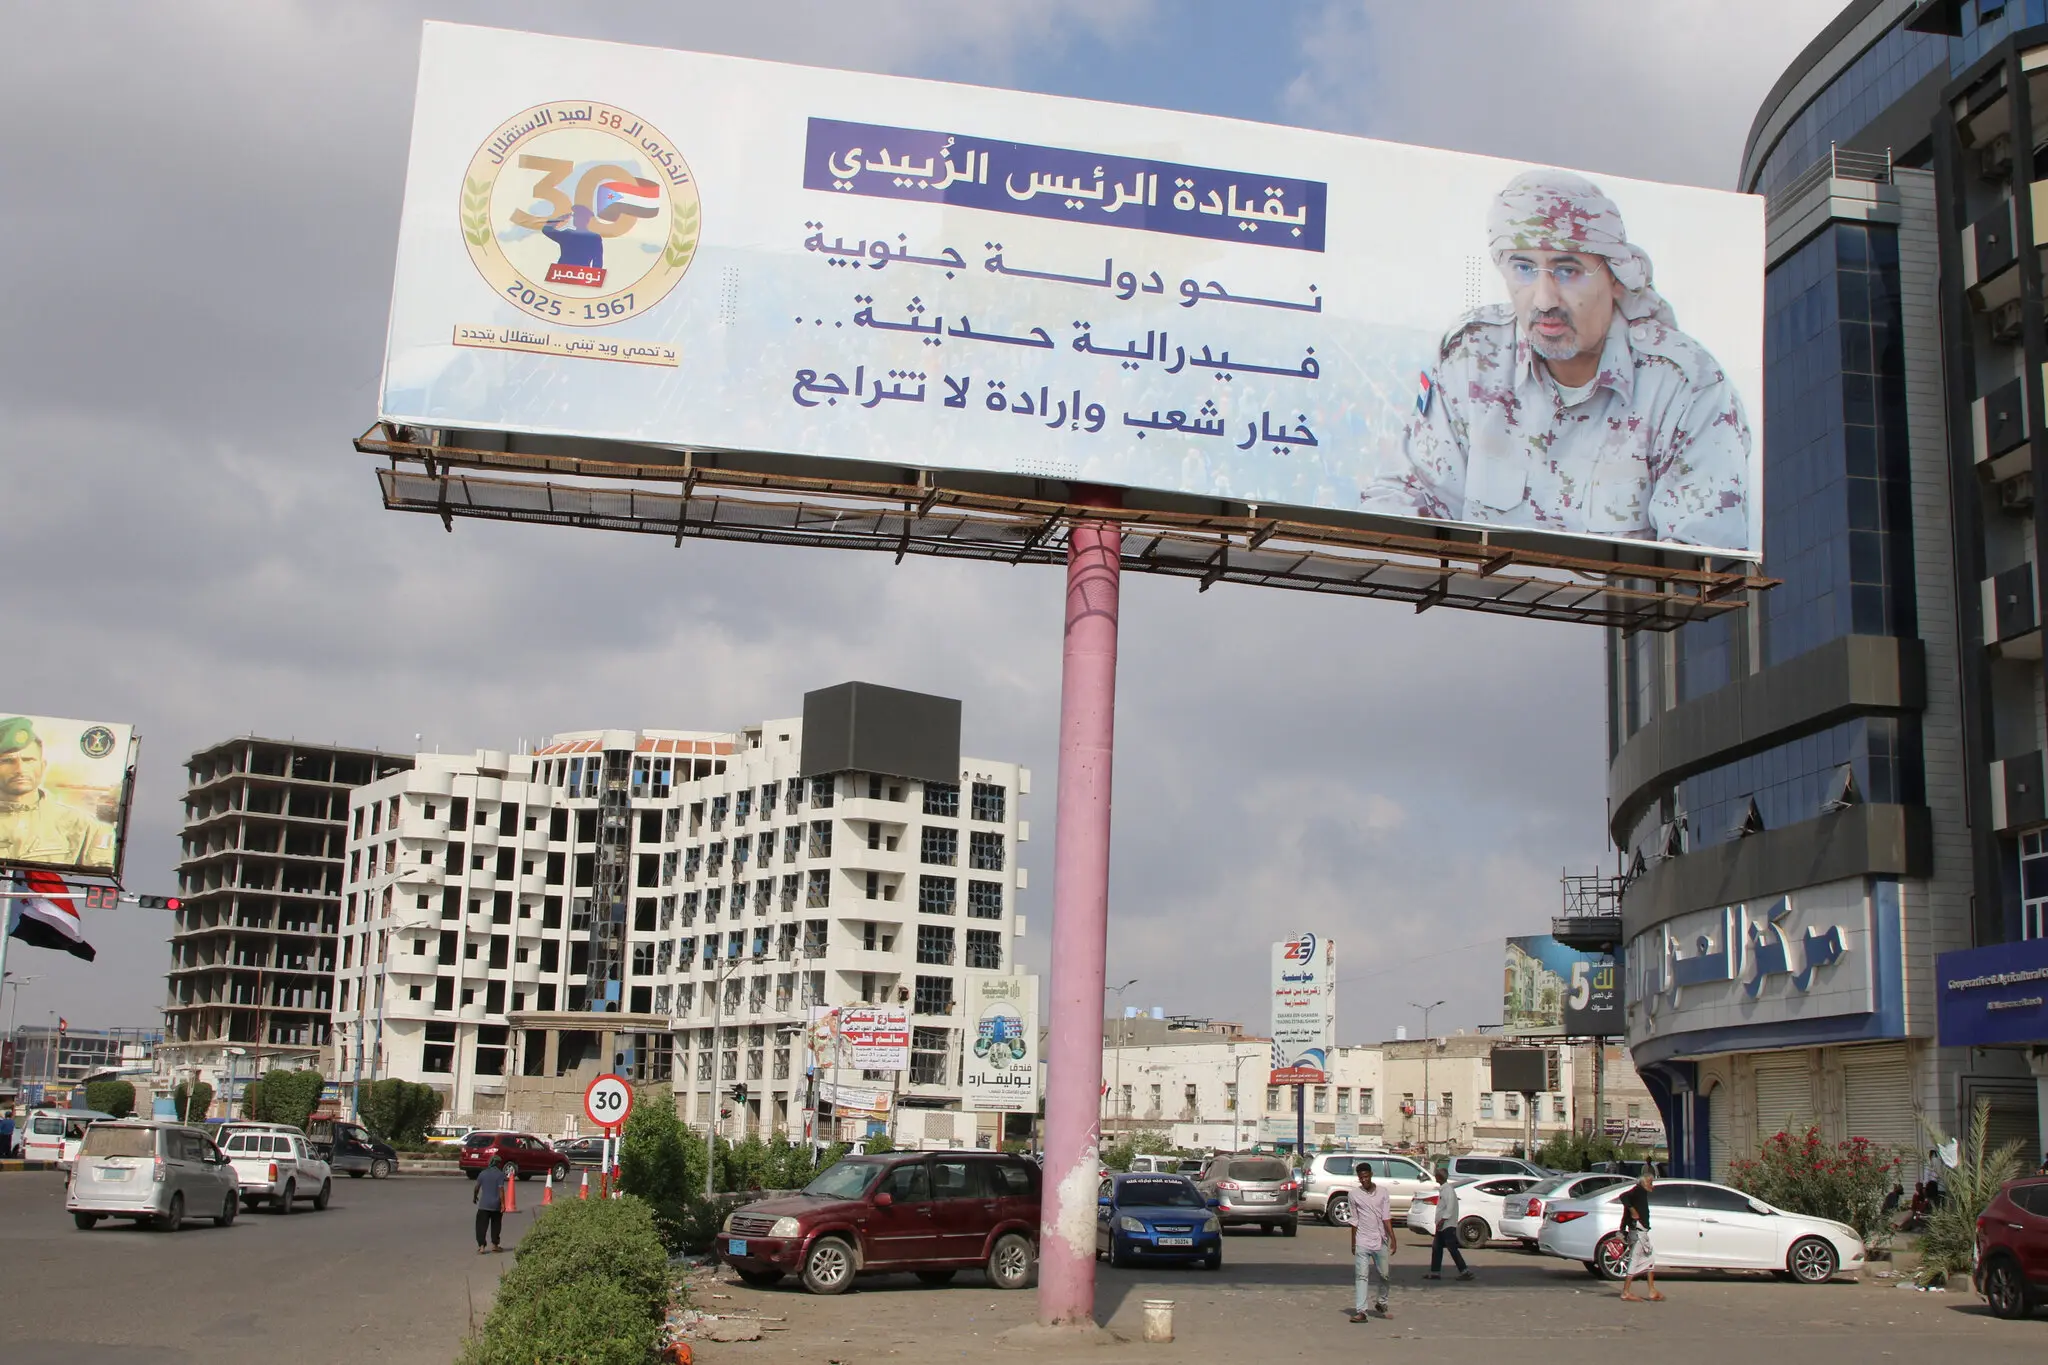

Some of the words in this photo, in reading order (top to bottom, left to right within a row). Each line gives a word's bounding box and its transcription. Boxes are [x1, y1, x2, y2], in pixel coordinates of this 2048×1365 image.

[557, 106, 593, 125] لعيد
[597, 110, 623, 130] 58
[487, 108, 553, 165] الاستقلال
[642, 137, 689, 186] الذكرى
[509, 154, 638, 239] 30
[1005, 165, 1157, 211] الرئيس
[1173, 177, 1307, 237] بقيادة
[803, 220, 967, 280] جنوبية
[551, 268, 602, 285] نوفمبر
[984, 241, 1164, 300] دولة
[506, 280, 562, 316] 2025
[583, 293, 636, 320] 1967
[1179, 278, 1322, 313] نحو
[460, 327, 495, 341] يتجدد
[499, 329, 550, 346] استقلال
[565, 339, 594, 353] تبني
[598, 342, 618, 355] ويد
[622, 346, 660, 360] تحمي
[664, 349, 676, 361] يد
[1072, 320, 1320, 382] فيدرالية
[792, 365, 927, 408] تتراجع
[943, 374, 970, 409] لا
[985, 379, 1106, 433] وإرادة
[1123, 399, 1225, 440] شعب
[1236, 411, 1319, 456] خيار
[86, 885, 117, 909] 22
[1743, 894, 1849, 999] مركز
[1282, 970, 1314, 984] مؤسسة
[1569, 961, 1590, 1011] 5
[1593, 967, 1615, 990] لك
[877, 1010, 906, 1025] شارع
[875, 1033, 904, 1047] سالم
[968, 1071, 1032, 1089] بوليفارد
[1009, 1063, 1032, 1072] فندق
[595, 1091, 622, 1110] 30
